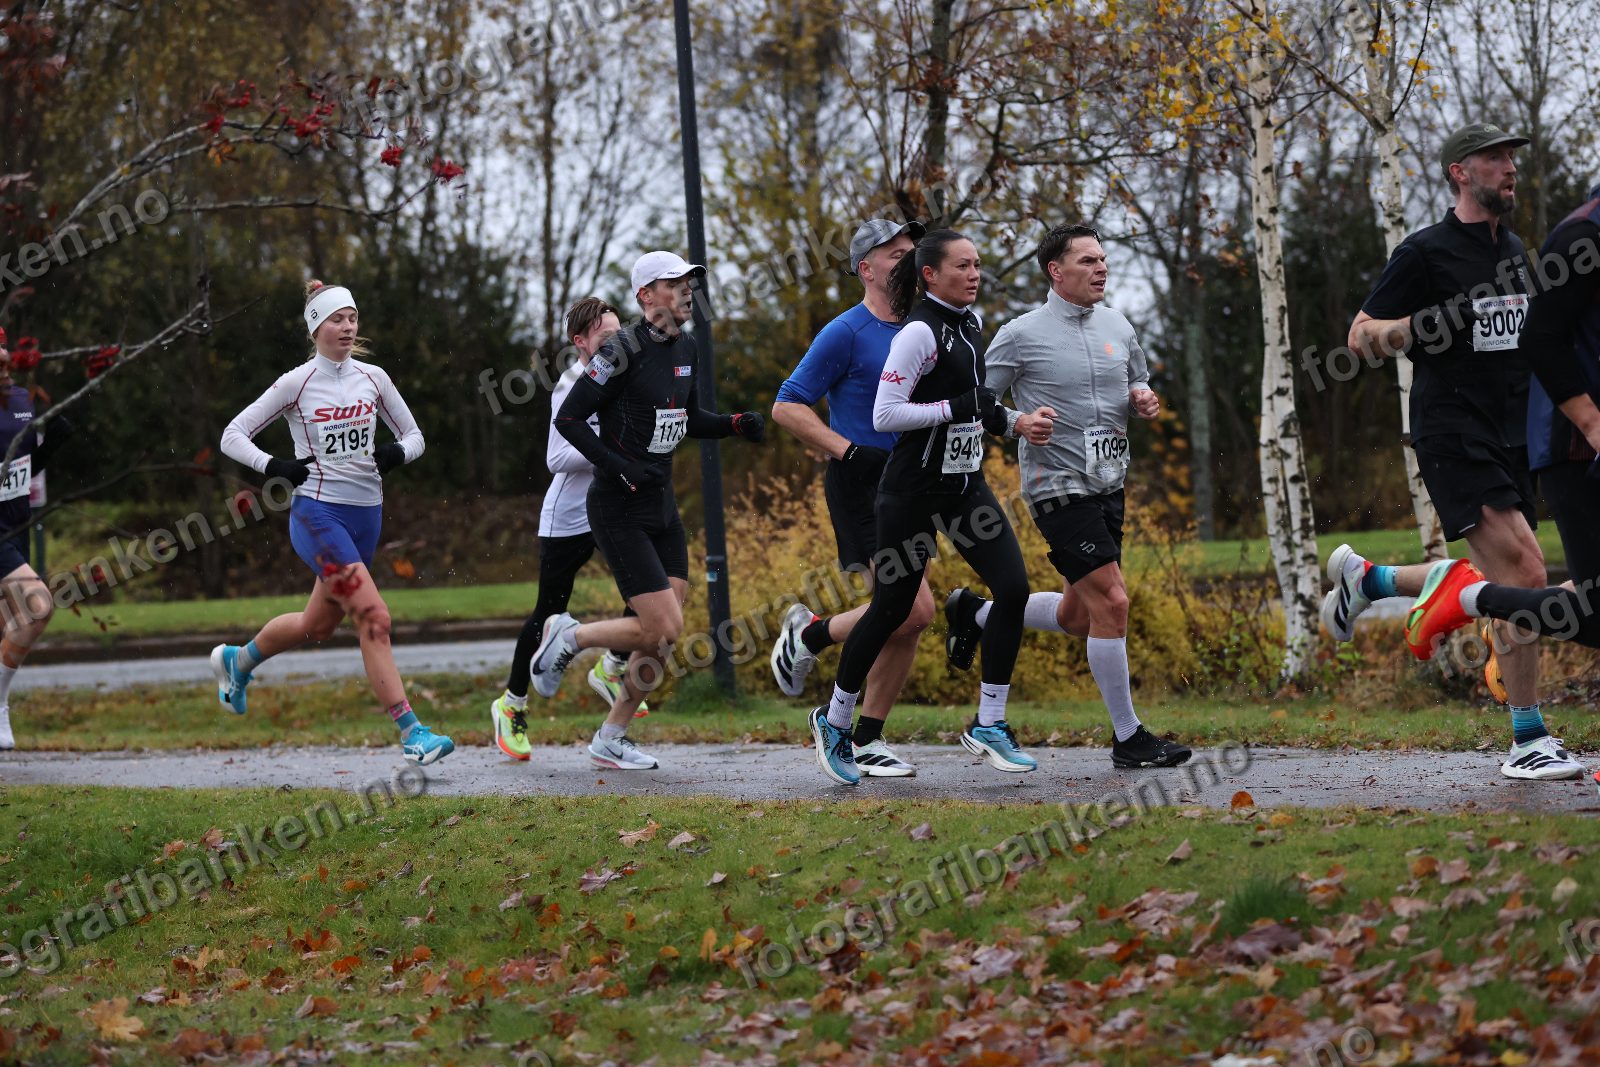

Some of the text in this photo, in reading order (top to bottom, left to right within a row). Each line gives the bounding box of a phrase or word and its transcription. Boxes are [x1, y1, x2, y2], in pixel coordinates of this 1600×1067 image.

[1479, 308, 1525, 338] 9002
[323, 418, 371, 431] NORGESTESTEN
[660, 420, 684, 443] 1173
[325, 427, 369, 455] 2195
[1091, 436, 1128, 461] 1099
